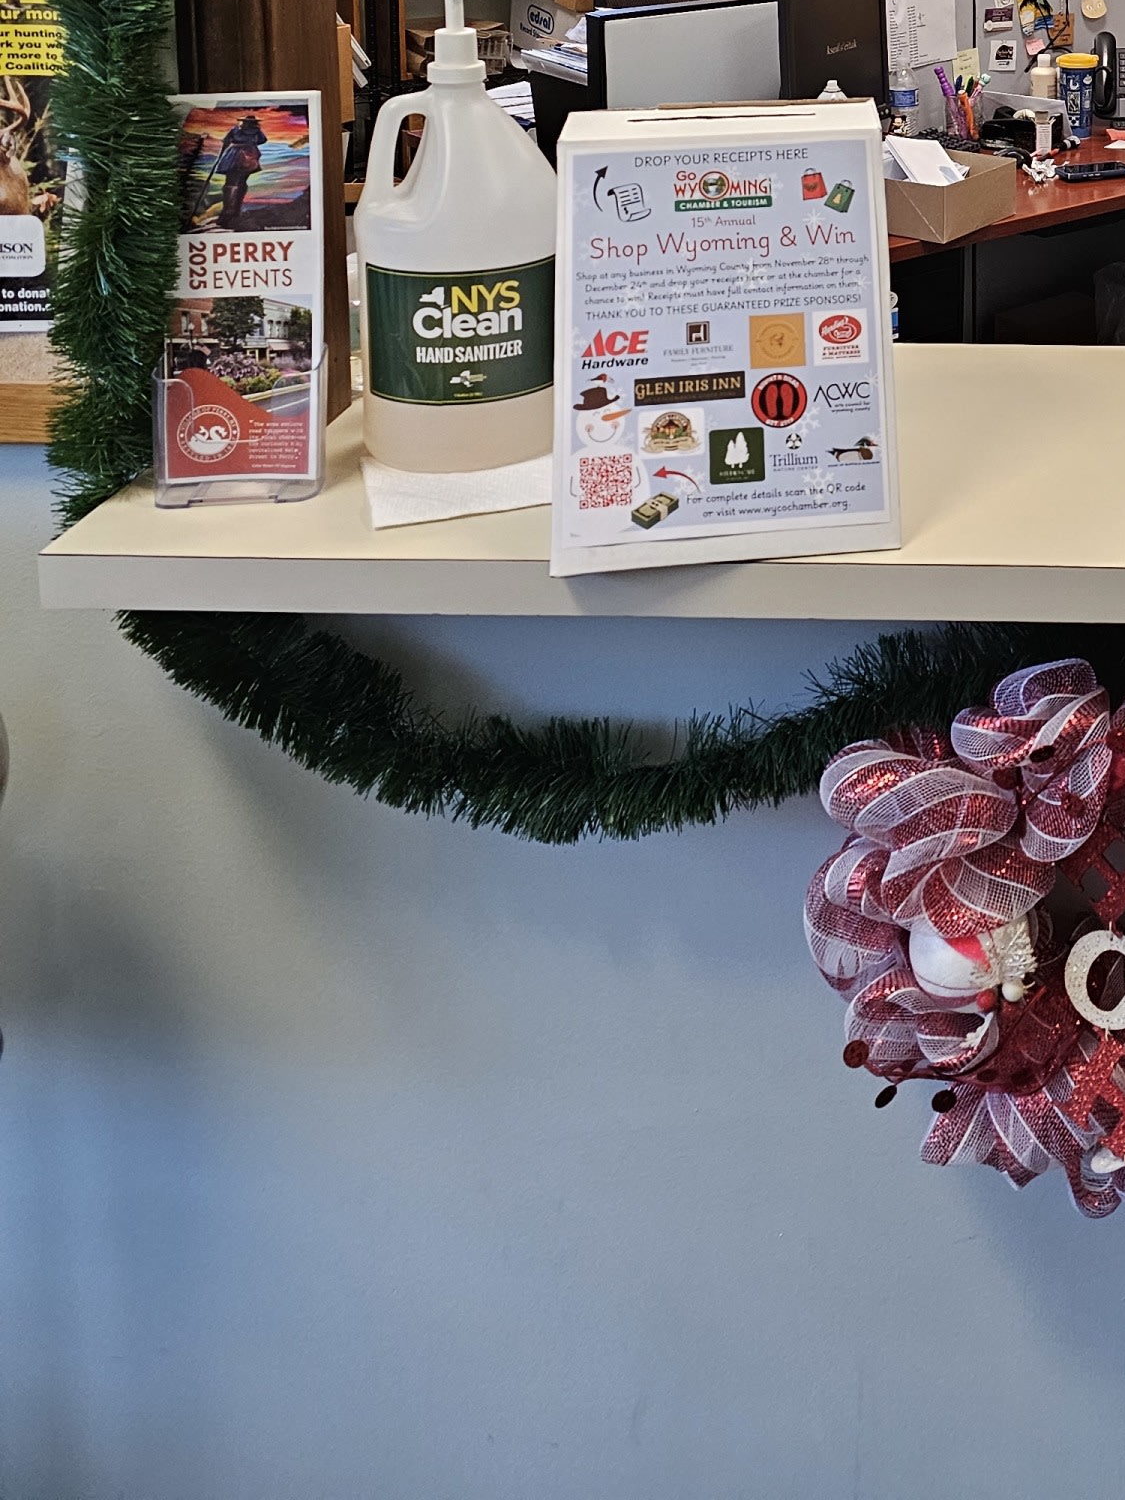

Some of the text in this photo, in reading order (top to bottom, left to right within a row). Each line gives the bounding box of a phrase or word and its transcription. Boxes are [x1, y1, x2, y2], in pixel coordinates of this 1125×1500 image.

[14, 29, 62, 40] hunting
[18, 41, 42, 50] you
[46, 51, 58, 60] to
[634, 148, 808, 168] DROP YOUR RECEIPTS HERE
[676, 170, 697, 182] Go
[679, 198, 768, 211] CHAMBER & TOURISM
[691, 215, 756, 228] 15th Annual
[212, 241, 294, 264] PERRY
[590, 224, 856, 265] Shop Wyoming & Win
[188, 241, 207, 290] 2025
[576, 271, 597, 281] Shop
[611, 273, 627, 281] any
[629, 269, 664, 278] business
[676, 265, 717, 276] Wyoming
[719, 261, 750, 272] County
[752, 260, 772, 272] from
[774, 259, 816, 268] November
[836, 255, 869, 266] through
[213, 268, 293, 289] EVENTS
[585, 283, 627, 292] December
[649, 279, 666, 288] and
[668, 278, 688, 290] drop
[690, 278, 708, 288] your
[711, 274, 743, 285] receipts
[767, 273, 775, 281] or
[778, 272, 786, 280] at
[788, 271, 801, 279] the
[803, 268, 839, 278] chamber
[841, 268, 853, 280] for
[1, 288, 15, 299] to
[451, 280, 521, 314] NYS
[584, 296, 614, 305] chance
[648, 291, 681, 301] Receipts
[683, 290, 704, 298] must
[706, 288, 725, 297] have
[727, 285, 742, 298] full
[743, 286, 773, 294] contact
[775, 283, 824, 295] information
[586, 294, 861, 321] THANK YOU TO THESE GUARANTEED PRIZE SPONSORS!
[412, 306, 523, 339] Clean
[416, 339, 523, 363] HAND SANITIZER
[581, 329, 649, 358] ACE
[581, 357, 649, 370] Hardware
[635, 376, 741, 399] GLEN IRIS INN
[813, 381, 871, 408] ACWC
[769, 453, 819, 467] Trillium
[686, 482, 866, 504] For complete details scan the QR code
[716, 506, 736, 516] visit
